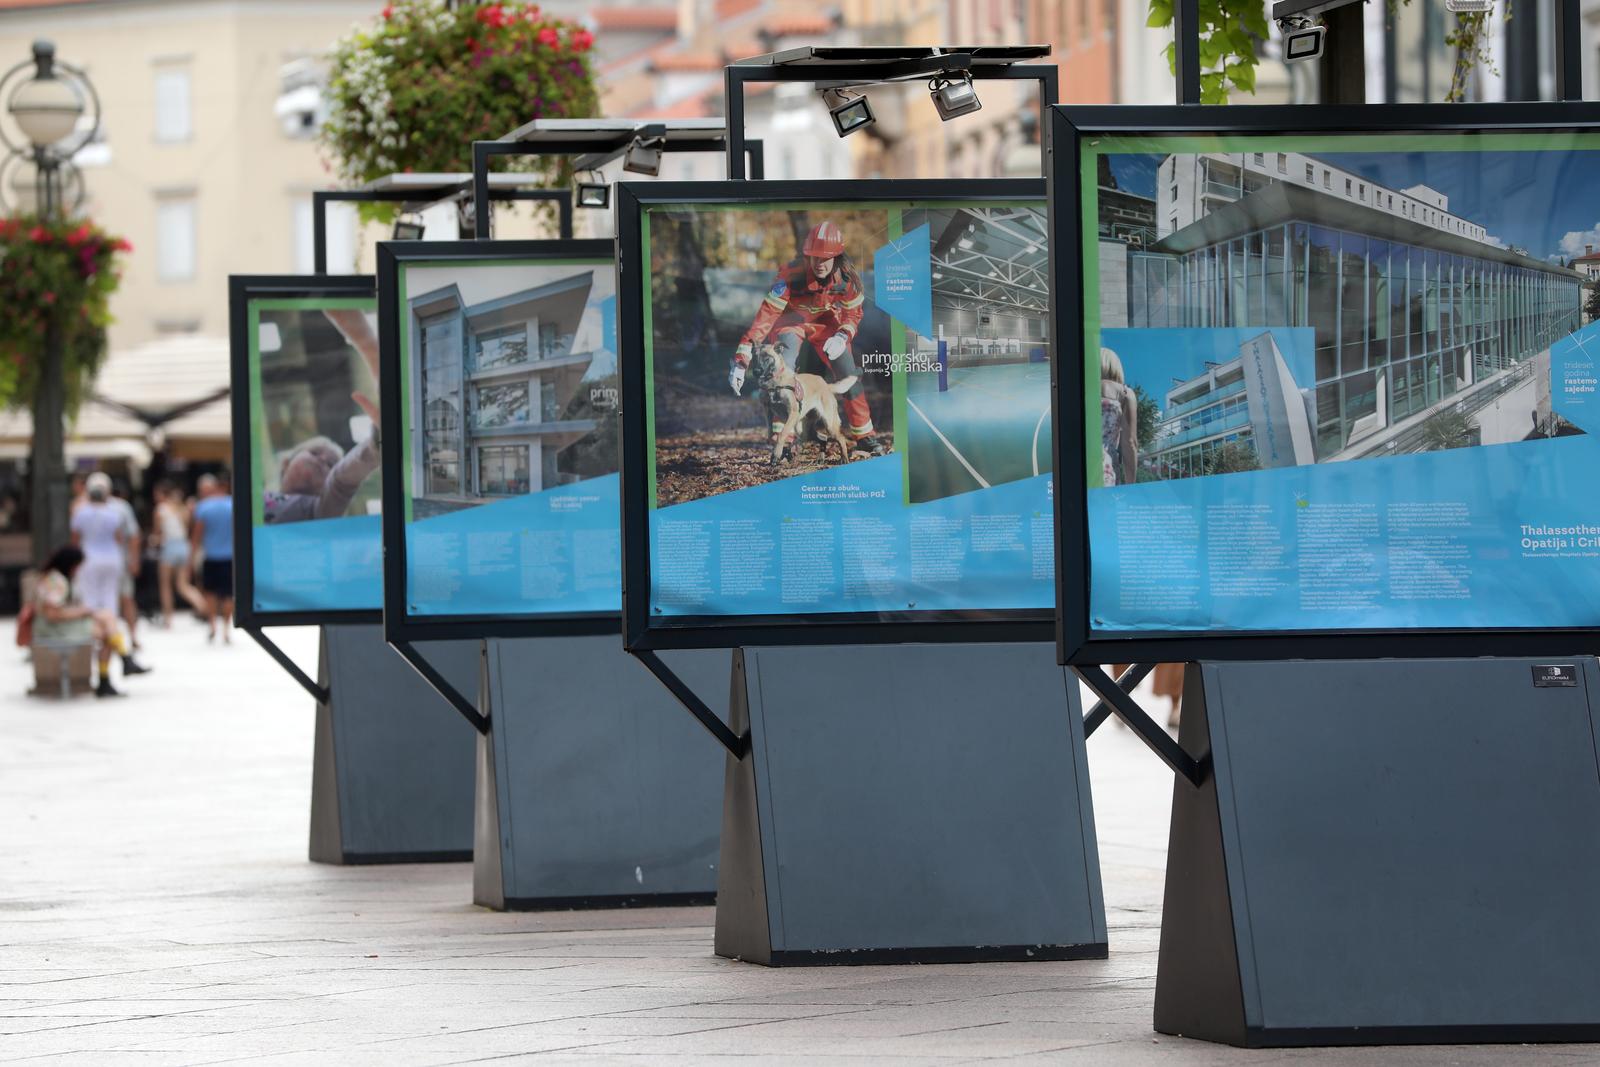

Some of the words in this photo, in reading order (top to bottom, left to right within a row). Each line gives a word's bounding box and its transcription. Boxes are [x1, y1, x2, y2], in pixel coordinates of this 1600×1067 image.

[862, 348, 928, 368] primorsko
[884, 357, 943, 377] goranska
[1564, 385, 1595, 395] zajedno
[870, 489, 886, 498] PGŽ
[1521, 537, 1568, 551] Opatija
